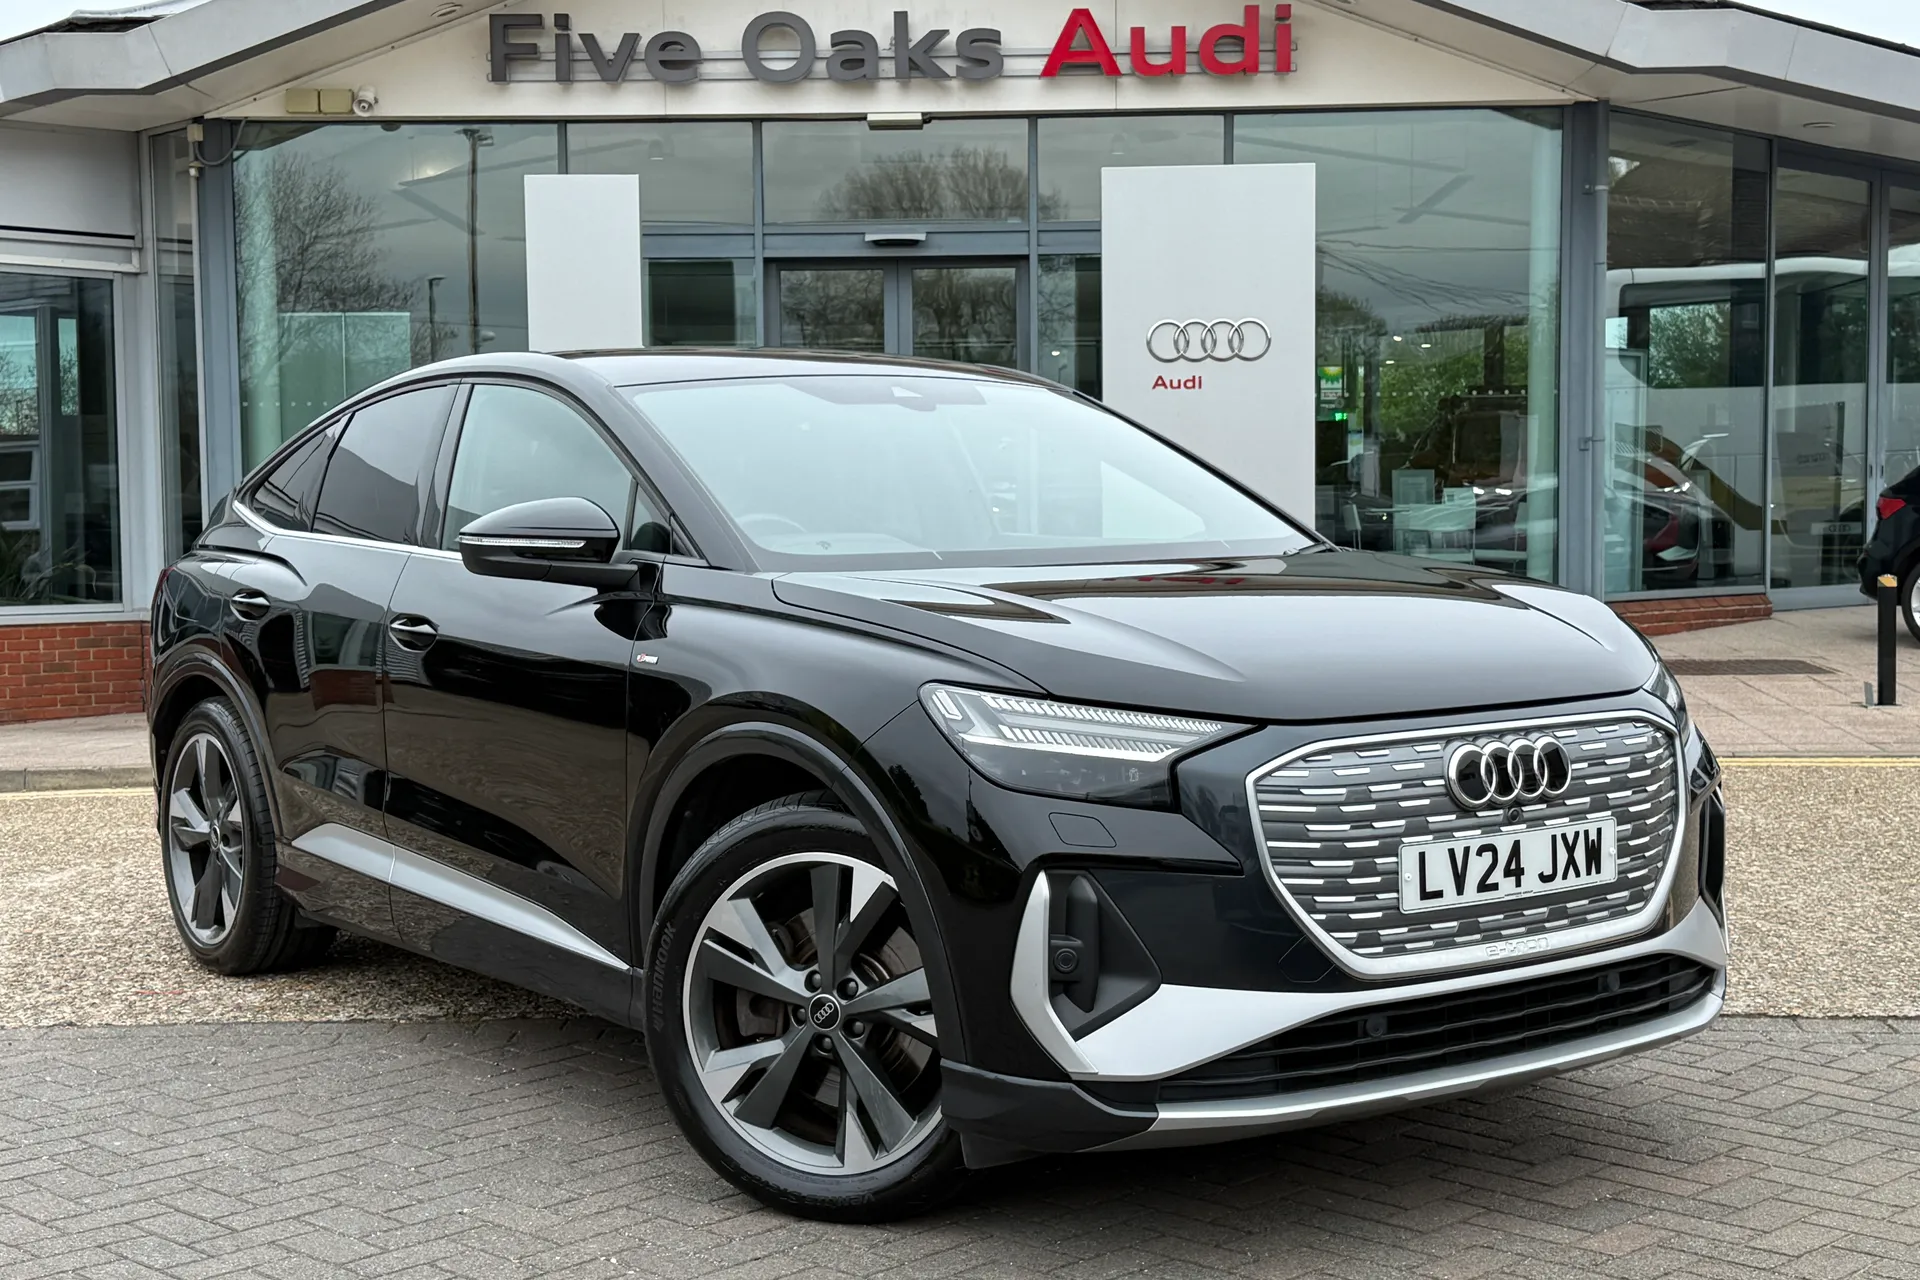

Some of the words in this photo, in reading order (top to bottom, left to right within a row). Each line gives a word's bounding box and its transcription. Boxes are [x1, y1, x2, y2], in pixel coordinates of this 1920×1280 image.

[489, 13, 702, 84] Five
[741, 11, 1004, 83] Oaks
[1040, 4, 1292, 77] Audi
[1152, 375, 1202, 390] Audi
[1419, 839, 1525, 901] LV24
[1538, 827, 1602, 883] JXW
